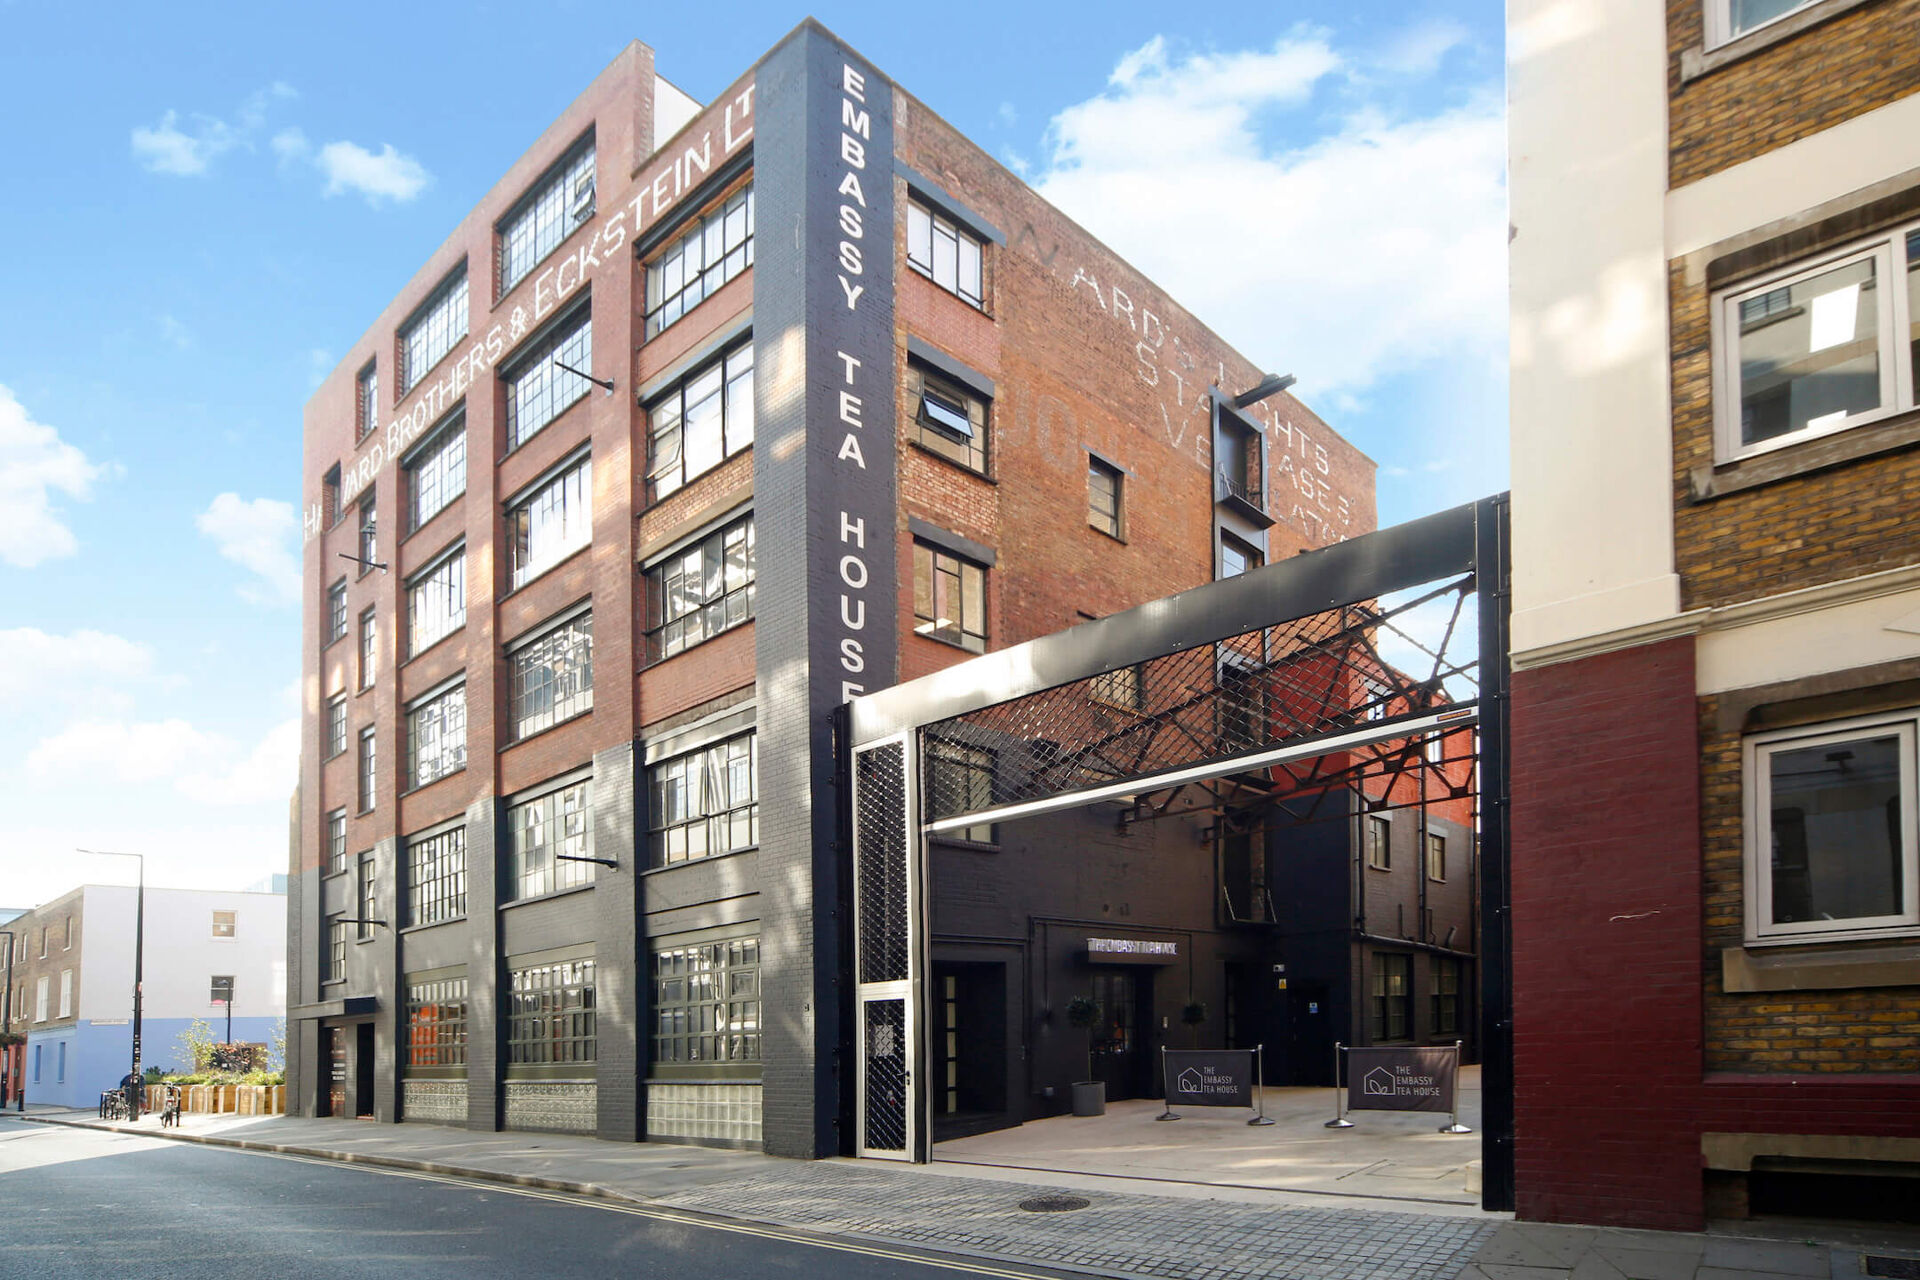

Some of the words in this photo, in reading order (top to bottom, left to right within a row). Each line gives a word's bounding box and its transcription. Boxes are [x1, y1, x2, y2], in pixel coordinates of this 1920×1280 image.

[837, 63, 870, 311] EMBASSY
[387, 324, 503, 461] BROTHERS
[510, 305, 527, 341] &
[535, 131, 711, 320] ECKSTEIN
[836, 350, 867, 470] TEA
[1203, 1066, 1215, 1075] THE
[1396, 1065, 1411, 1075] THE
[1203, 1075, 1233, 1084] EMBASSY
[1396, 1076, 1433, 1085] EMBASSY
[1203, 1085, 1215, 1094] TEA
[1216, 1085, 1238, 1094] HOUSE
[1396, 1086, 1412, 1096] TEA
[1413, 1086, 1440, 1096] HOUSE
